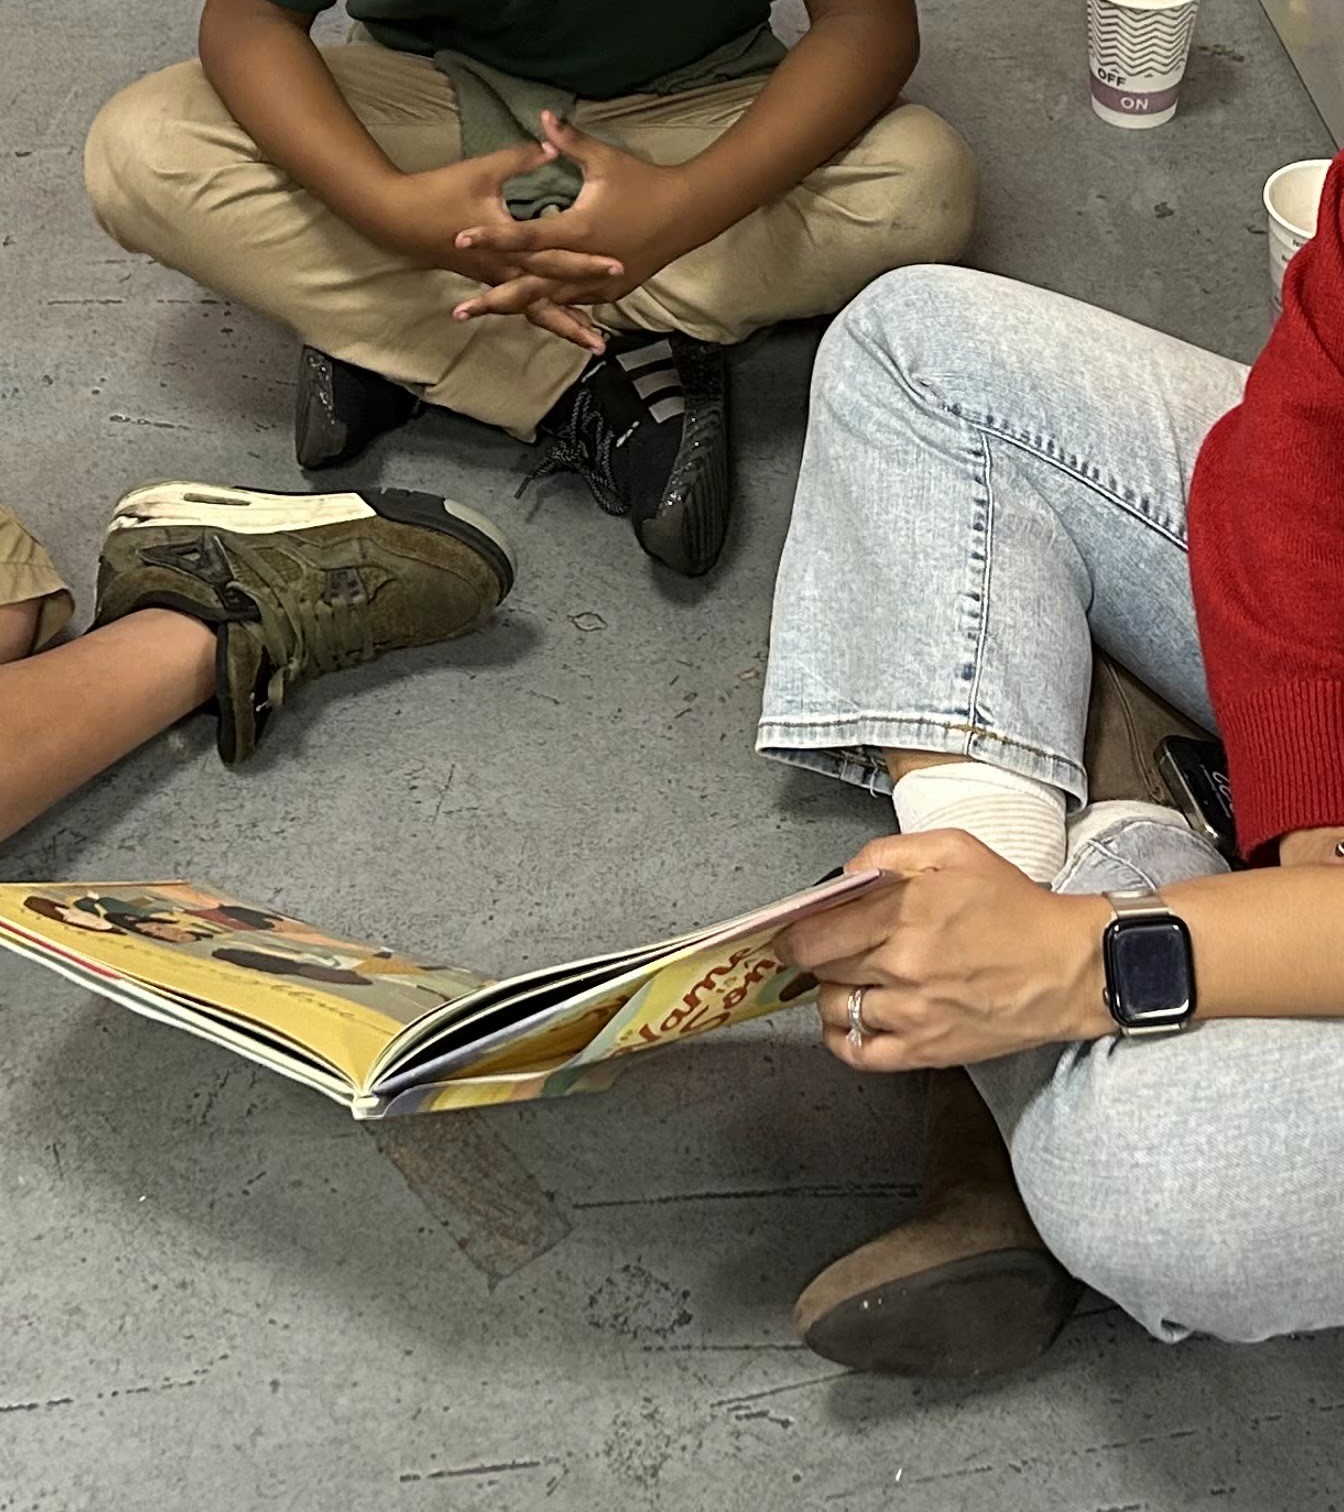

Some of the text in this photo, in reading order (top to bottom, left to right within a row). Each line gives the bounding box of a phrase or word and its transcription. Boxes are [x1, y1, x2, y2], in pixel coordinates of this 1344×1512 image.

[1096, 67, 1127, 88] OFF
[1120, 95, 1150, 112] ON
[680, 958, 790, 1034] Son
